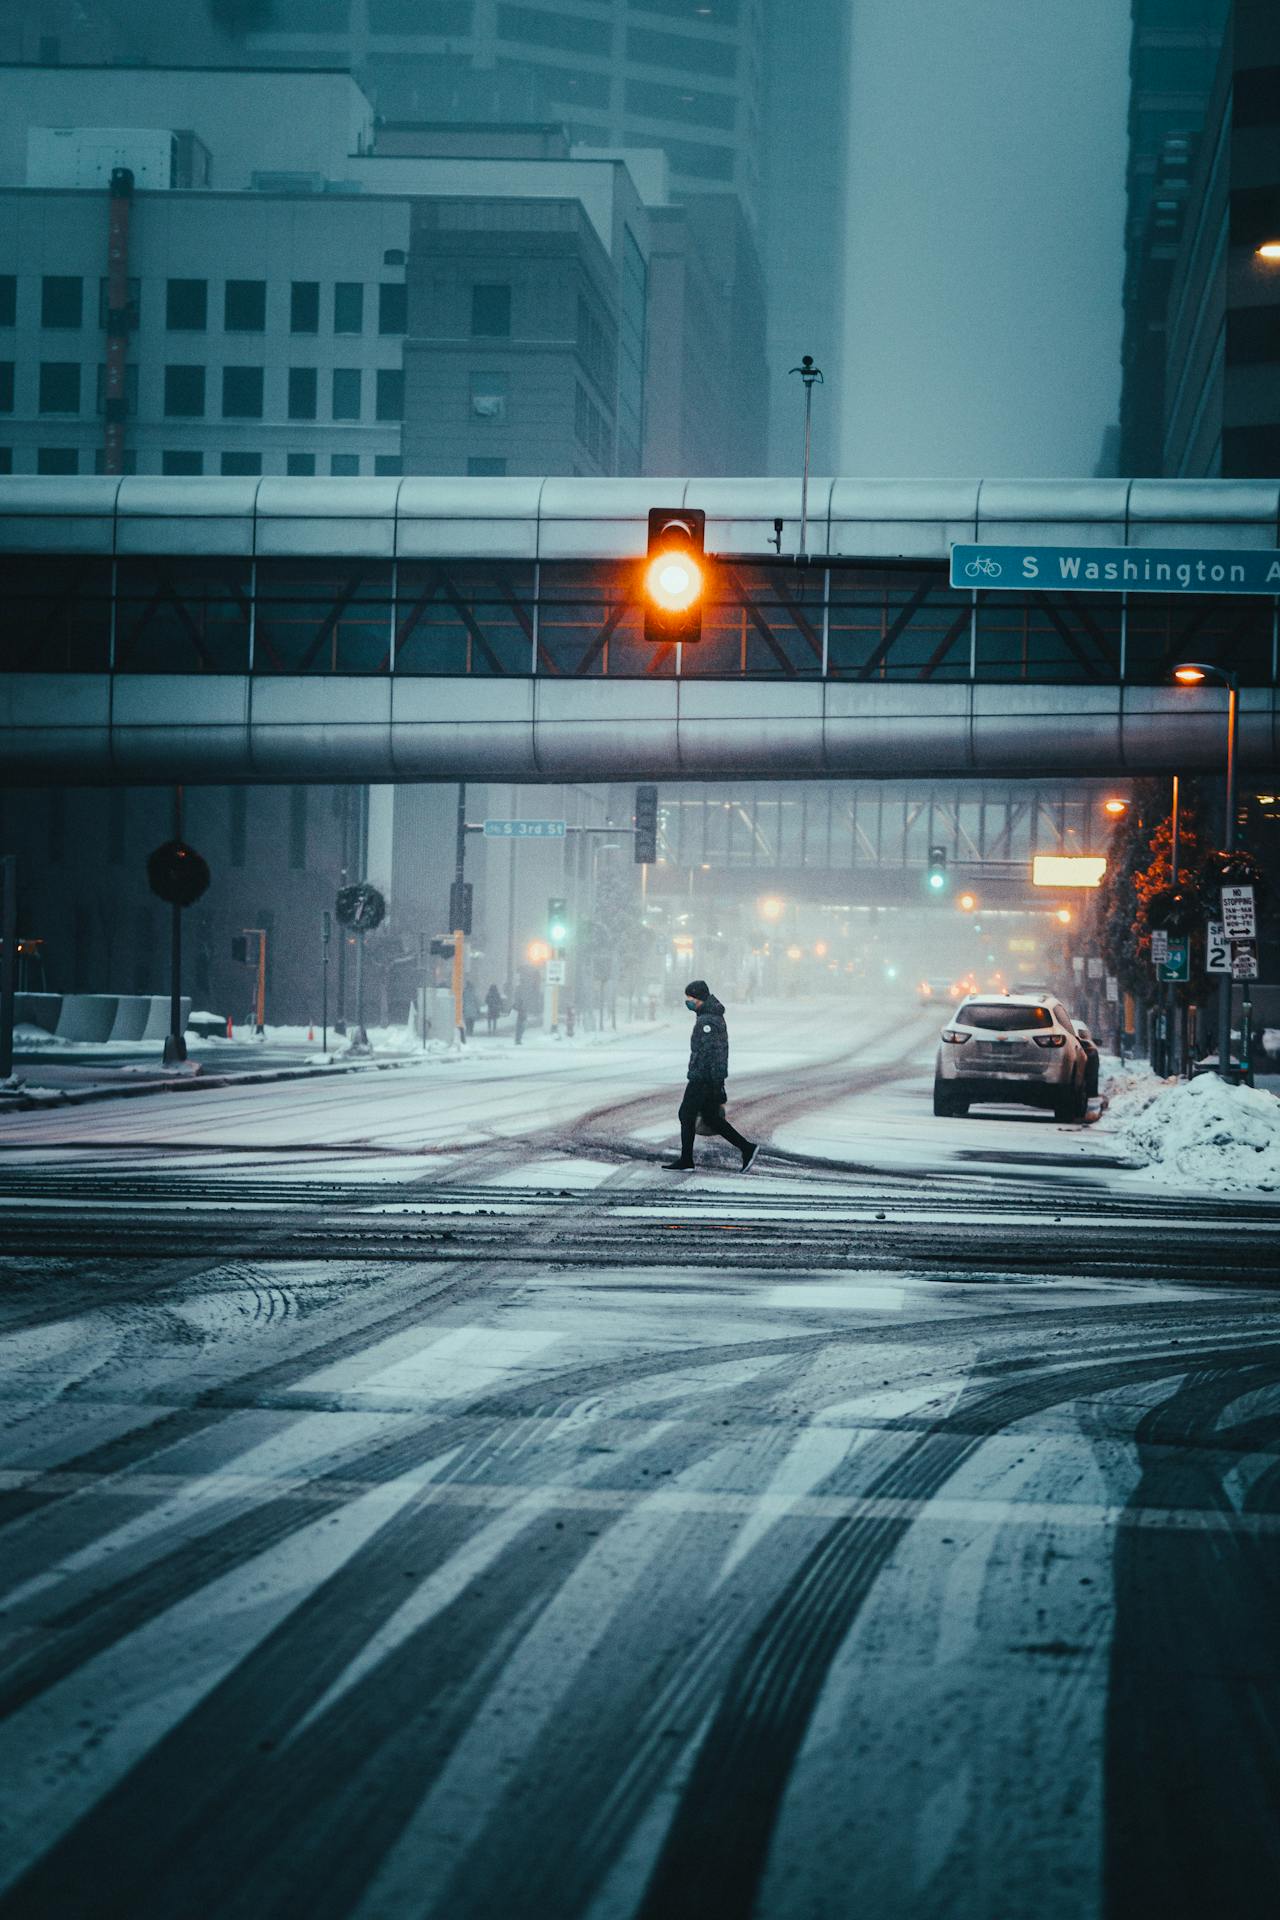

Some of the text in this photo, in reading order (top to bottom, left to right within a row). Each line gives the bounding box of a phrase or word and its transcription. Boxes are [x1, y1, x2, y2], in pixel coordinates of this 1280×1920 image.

[1022, 556, 1039, 579] S
[1059, 557, 1245, 587] Washington
[503, 823, 562, 835] S 3rd St
[1232, 889, 1242, 897] NO
[1224, 898, 1252, 906] STOPPING
